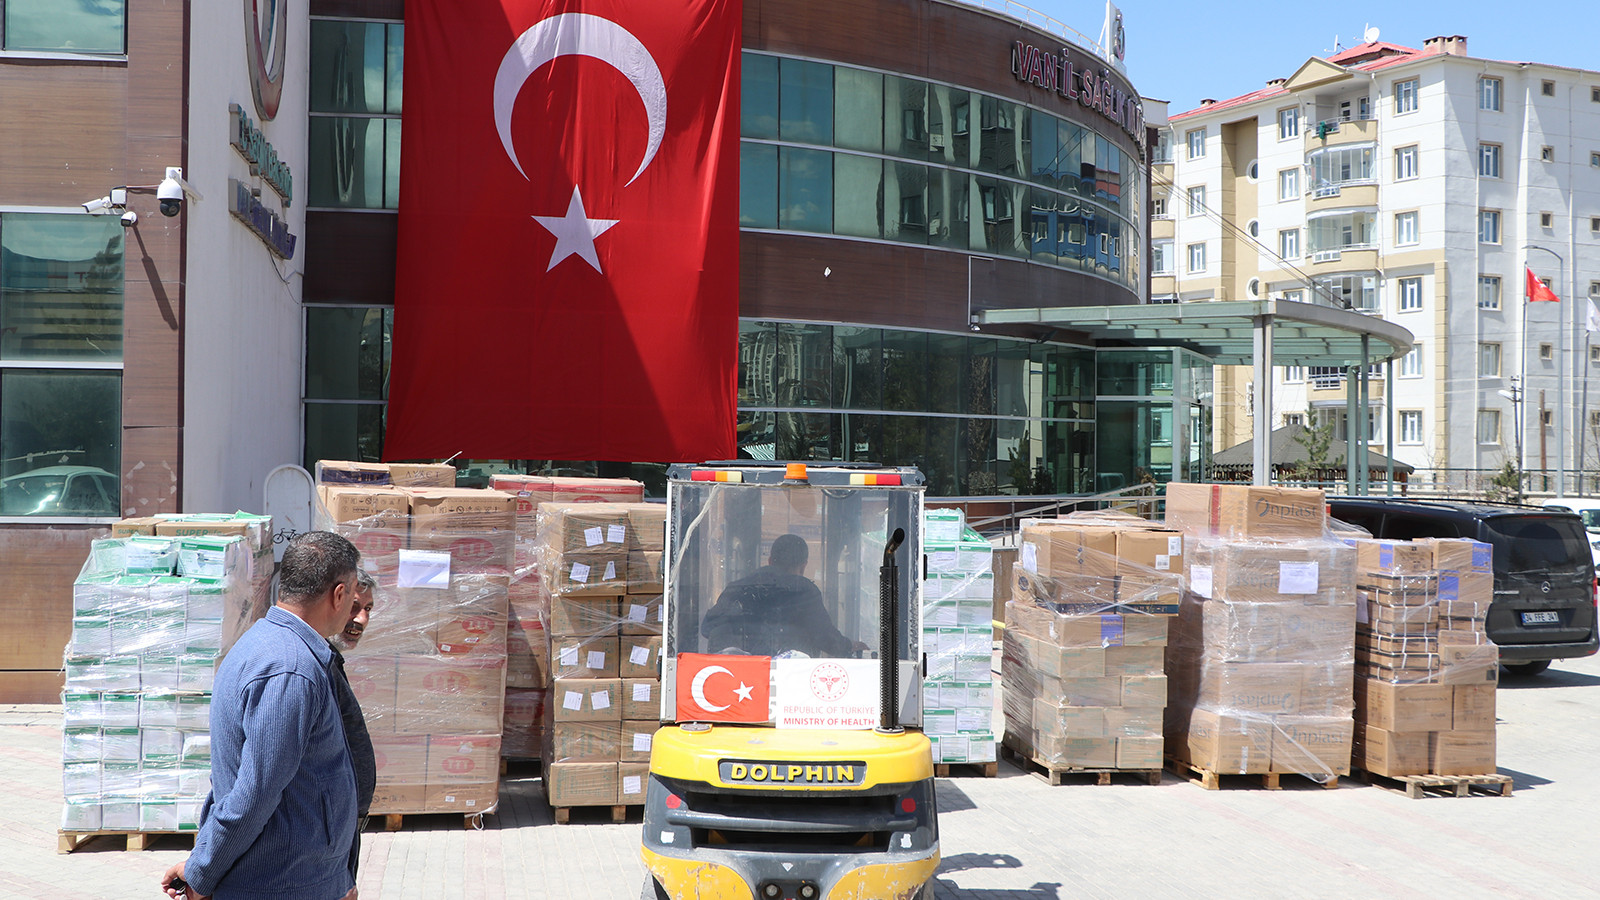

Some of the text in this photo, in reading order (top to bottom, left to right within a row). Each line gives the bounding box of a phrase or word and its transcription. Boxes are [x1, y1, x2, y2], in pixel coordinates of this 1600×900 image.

[1015, 40, 1058, 92] VAN
[1062, 47, 1079, 100] İL
[1082, 68, 1127, 128] SAĞLIK
[783, 706, 823, 715] REPUBLIC
[826, 706, 838, 715] OF
[783, 717, 875, 726] MINISTRY OF HEALTH
[730, 763, 855, 782] DOLPHIN
